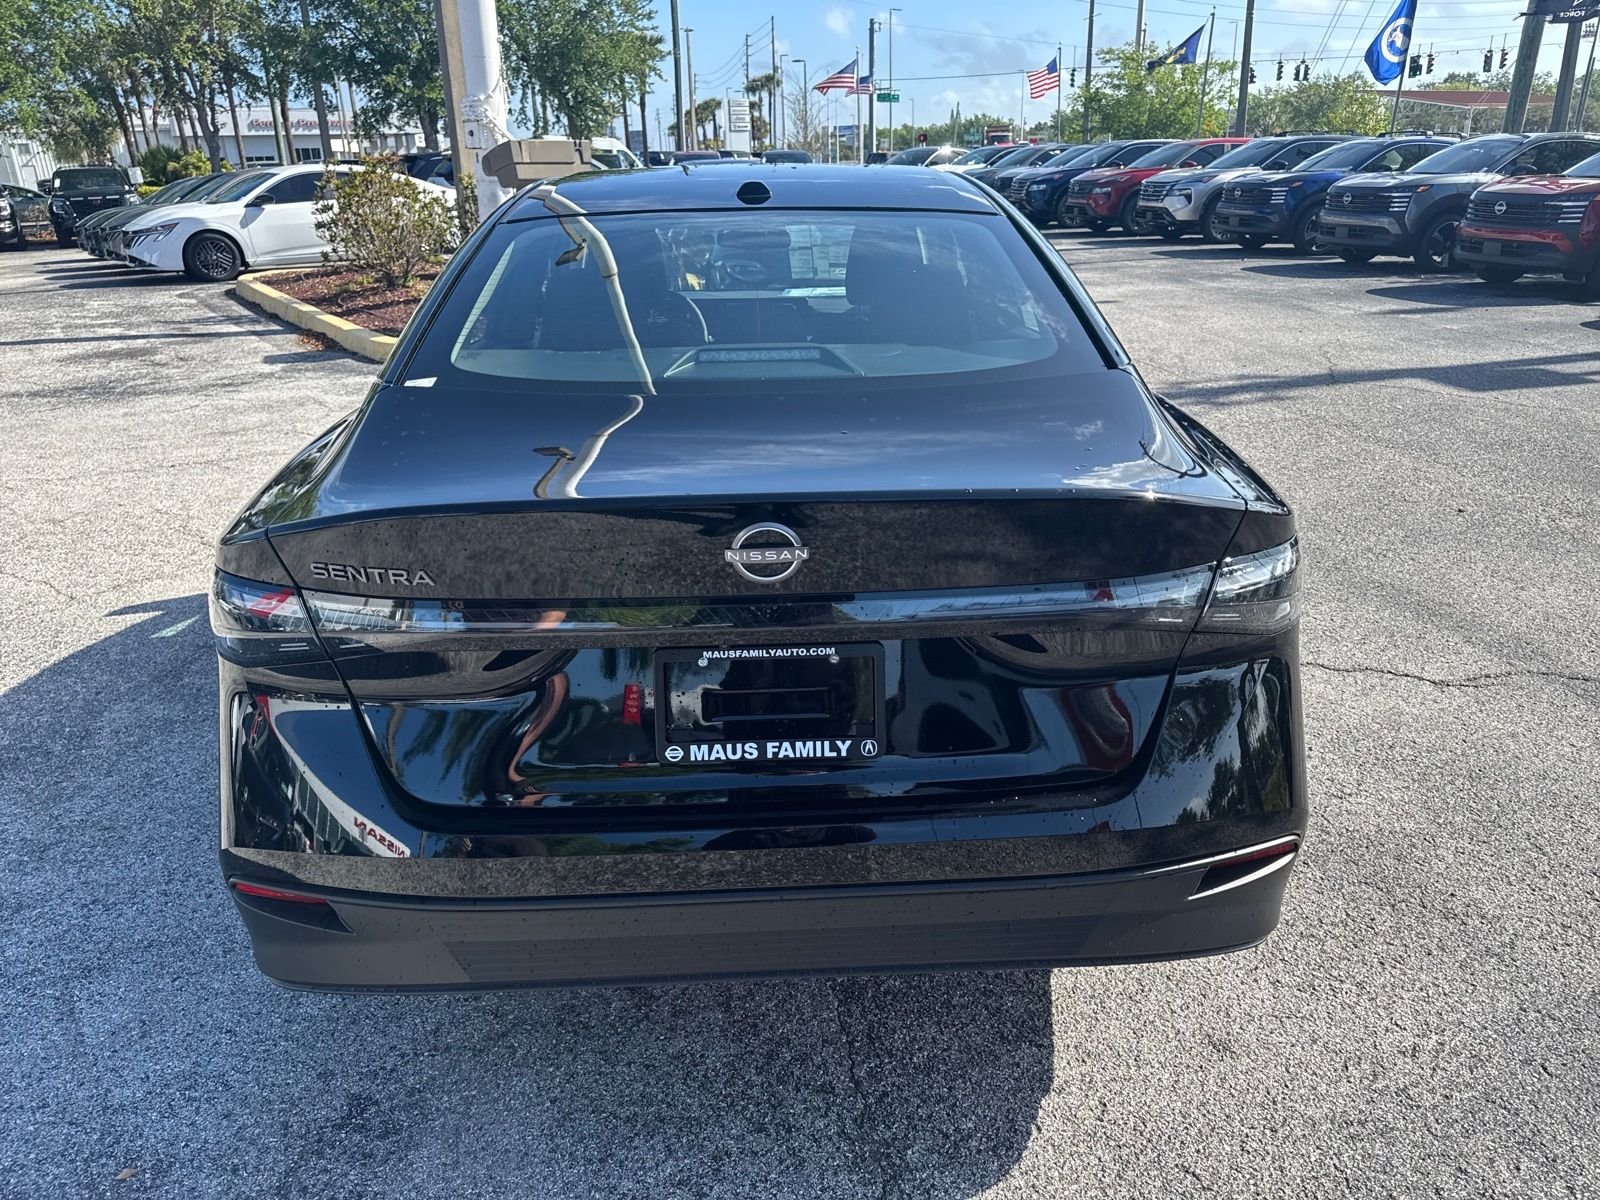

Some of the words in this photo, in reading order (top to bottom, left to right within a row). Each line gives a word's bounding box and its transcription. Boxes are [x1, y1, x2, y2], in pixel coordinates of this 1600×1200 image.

[727, 548, 807, 561] NISSAN
[310, 562, 436, 586] SENTRA
[702, 647, 835, 659] MAUSFAMILYAUTO.COM
[690, 744, 759, 761] MAUS
[766, 740, 852, 759] FAMILY
